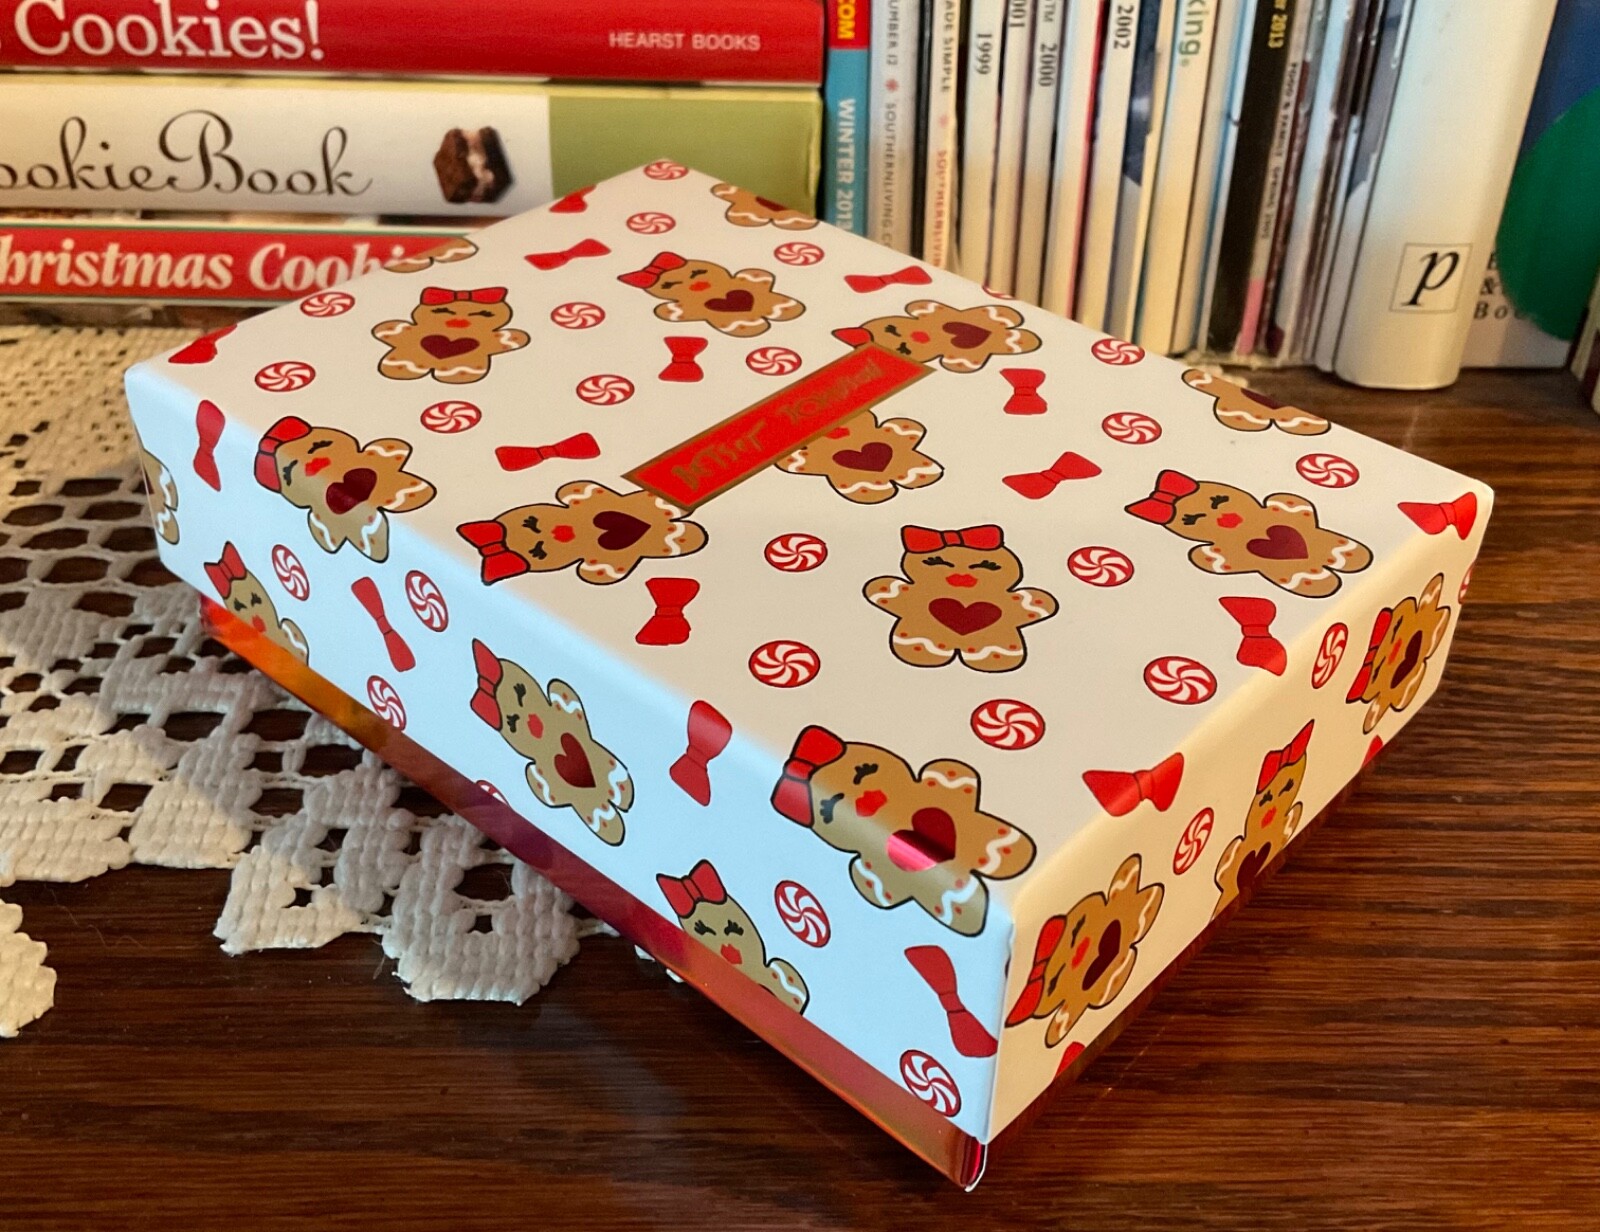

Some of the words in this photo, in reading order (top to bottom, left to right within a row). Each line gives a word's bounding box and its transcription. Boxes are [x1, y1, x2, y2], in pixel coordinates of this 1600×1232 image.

[15, 0, 324, 61] Cookies!
[837, 0, 856, 40] OM
[887, 0, 899, 49] UMBER
[944, 0, 956, 32] ADE
[1008, 0, 1027, 28] 001
[1113, 4, 1135, 50] 2002
[1267, 14, 1288, 49] 2013
[608, 32, 684, 50] HEARST
[691, 33, 762, 53] BOOKS
[941, 36, 954, 93] SIMPLE
[976, 31, 994, 75] 1999
[1038, 42, 1058, 87] 2000
[0, 116, 170, 191] ookie
[838, 98, 858, 183] WINTER
[932, 150, 949, 268] SOUTHERNLIVIN
[0, 234, 233, 290] hristmas
[1401, 250, 1460, 306] p
